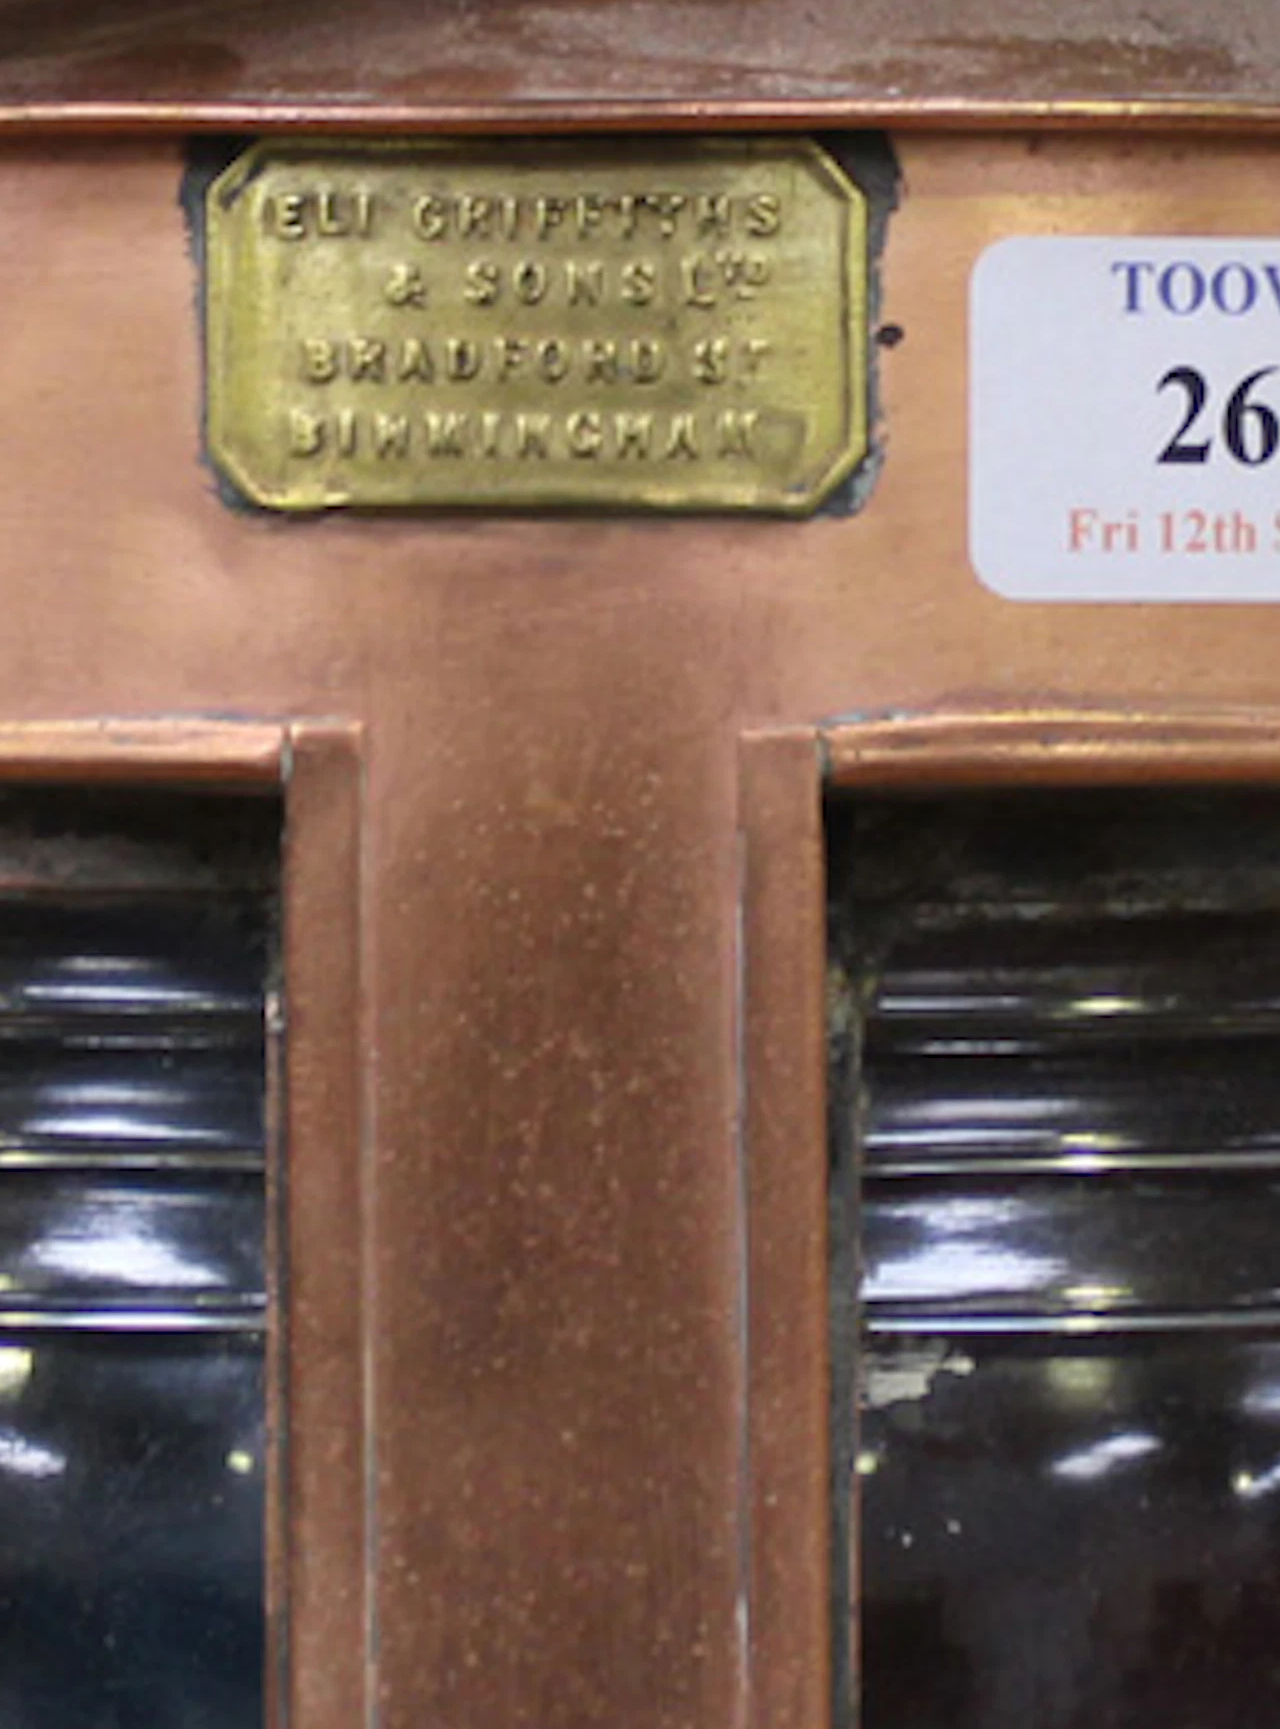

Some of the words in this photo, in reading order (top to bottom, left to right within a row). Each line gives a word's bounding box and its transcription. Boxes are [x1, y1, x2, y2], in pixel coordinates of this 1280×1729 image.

[272, 186, 376, 242] ELI
[383, 262, 426, 308] &
[462, 260, 660, 306] SONS
[302, 334, 668, 386] BRADFORD
[286, 406, 762, 462] BIRMINGHAM
[1067, 508, 1140, 553] Fri
[1160, 510, 1257, 554] 12th
